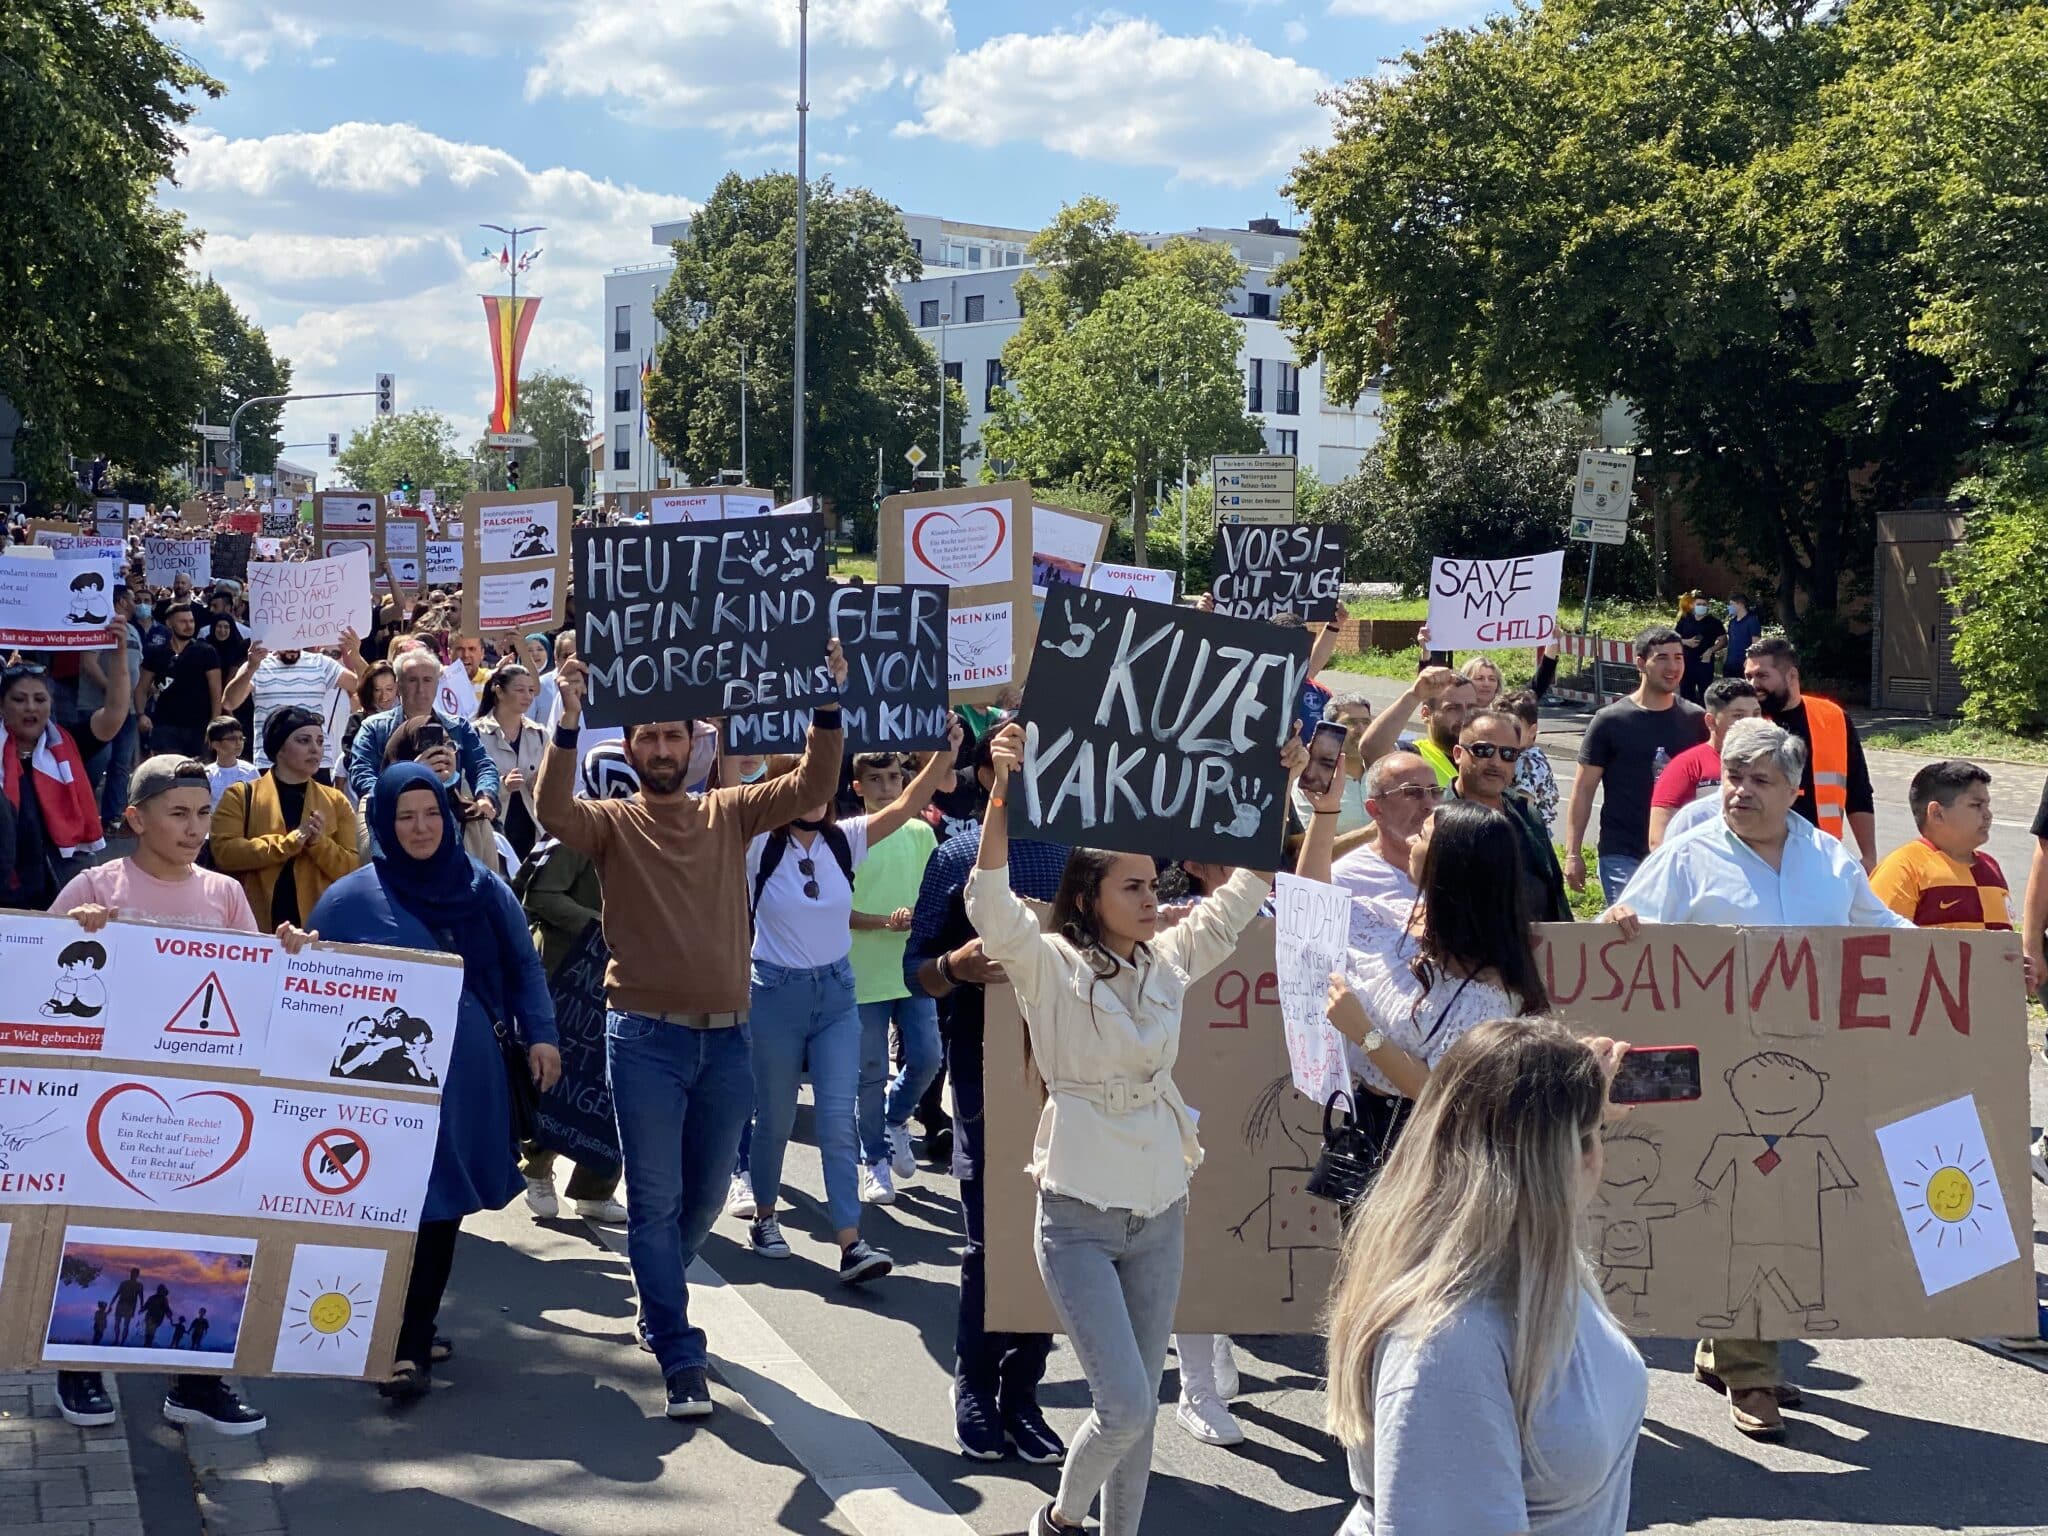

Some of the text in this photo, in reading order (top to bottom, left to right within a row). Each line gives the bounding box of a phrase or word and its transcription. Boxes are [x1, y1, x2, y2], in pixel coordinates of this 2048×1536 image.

[663, 498, 707, 508] VORSICHT
[484, 516, 532, 527] FALSCHEN
[148, 541, 210, 556] VORSICHT
[1221, 525, 1341, 574] VORSI-
[148, 556, 196, 571] JUGEND
[587, 531, 746, 600] HEUTE
[250, 562, 347, 589] #KUZEY
[1106, 570, 1157, 583] VORSICHT
[1212, 570, 1273, 602] CHT
[1435, 557, 1534, 597] SAVE
[254, 603, 335, 624] ARE NOT
[1463, 591, 1517, 619] MY
[584, 588, 817, 655] MEIN KIND
[950, 610, 1007, 626] MEIN Kind
[1476, 614, 1554, 642] CHILD
[46, 633, 65, 643] Welt
[587, 640, 769, 706] MORGEN
[860, 650, 938, 696] VON
[964, 663, 1008, 681] DEINS!
[1093, 606, 1309, 755] KUZEY
[730, 699, 947, 748] MEINM KIND
[1023, 720, 1234, 830] YAKUP
[6, 932, 44, 945] nimmt
[155, 938, 274, 964] VORSICHT
[287, 957, 404, 984] Inobhutnahme im
[283, 976, 398, 1004] FALSCHEN
[280, 997, 345, 1016] Rahmen!
[13, 1029, 39, 1042] Welt
[153, 1037, 235, 1056] Jugendamt
[37, 1081, 79, 1097] Kind
[121, 1111, 222, 1129] Kinder haben Rechte!
[272, 1098, 425, 1131] Finger WEG von
[117, 1127, 221, 1146] Ein Recht auf Familie!
[119, 1141, 214, 1159] Ein Recht auf Liebe!
[131, 1155, 196, 1171] Ein Recht auf
[127, 1170, 196, 1183] ihre ELTERN!
[257, 1193, 408, 1225] MEINEM Kind!
